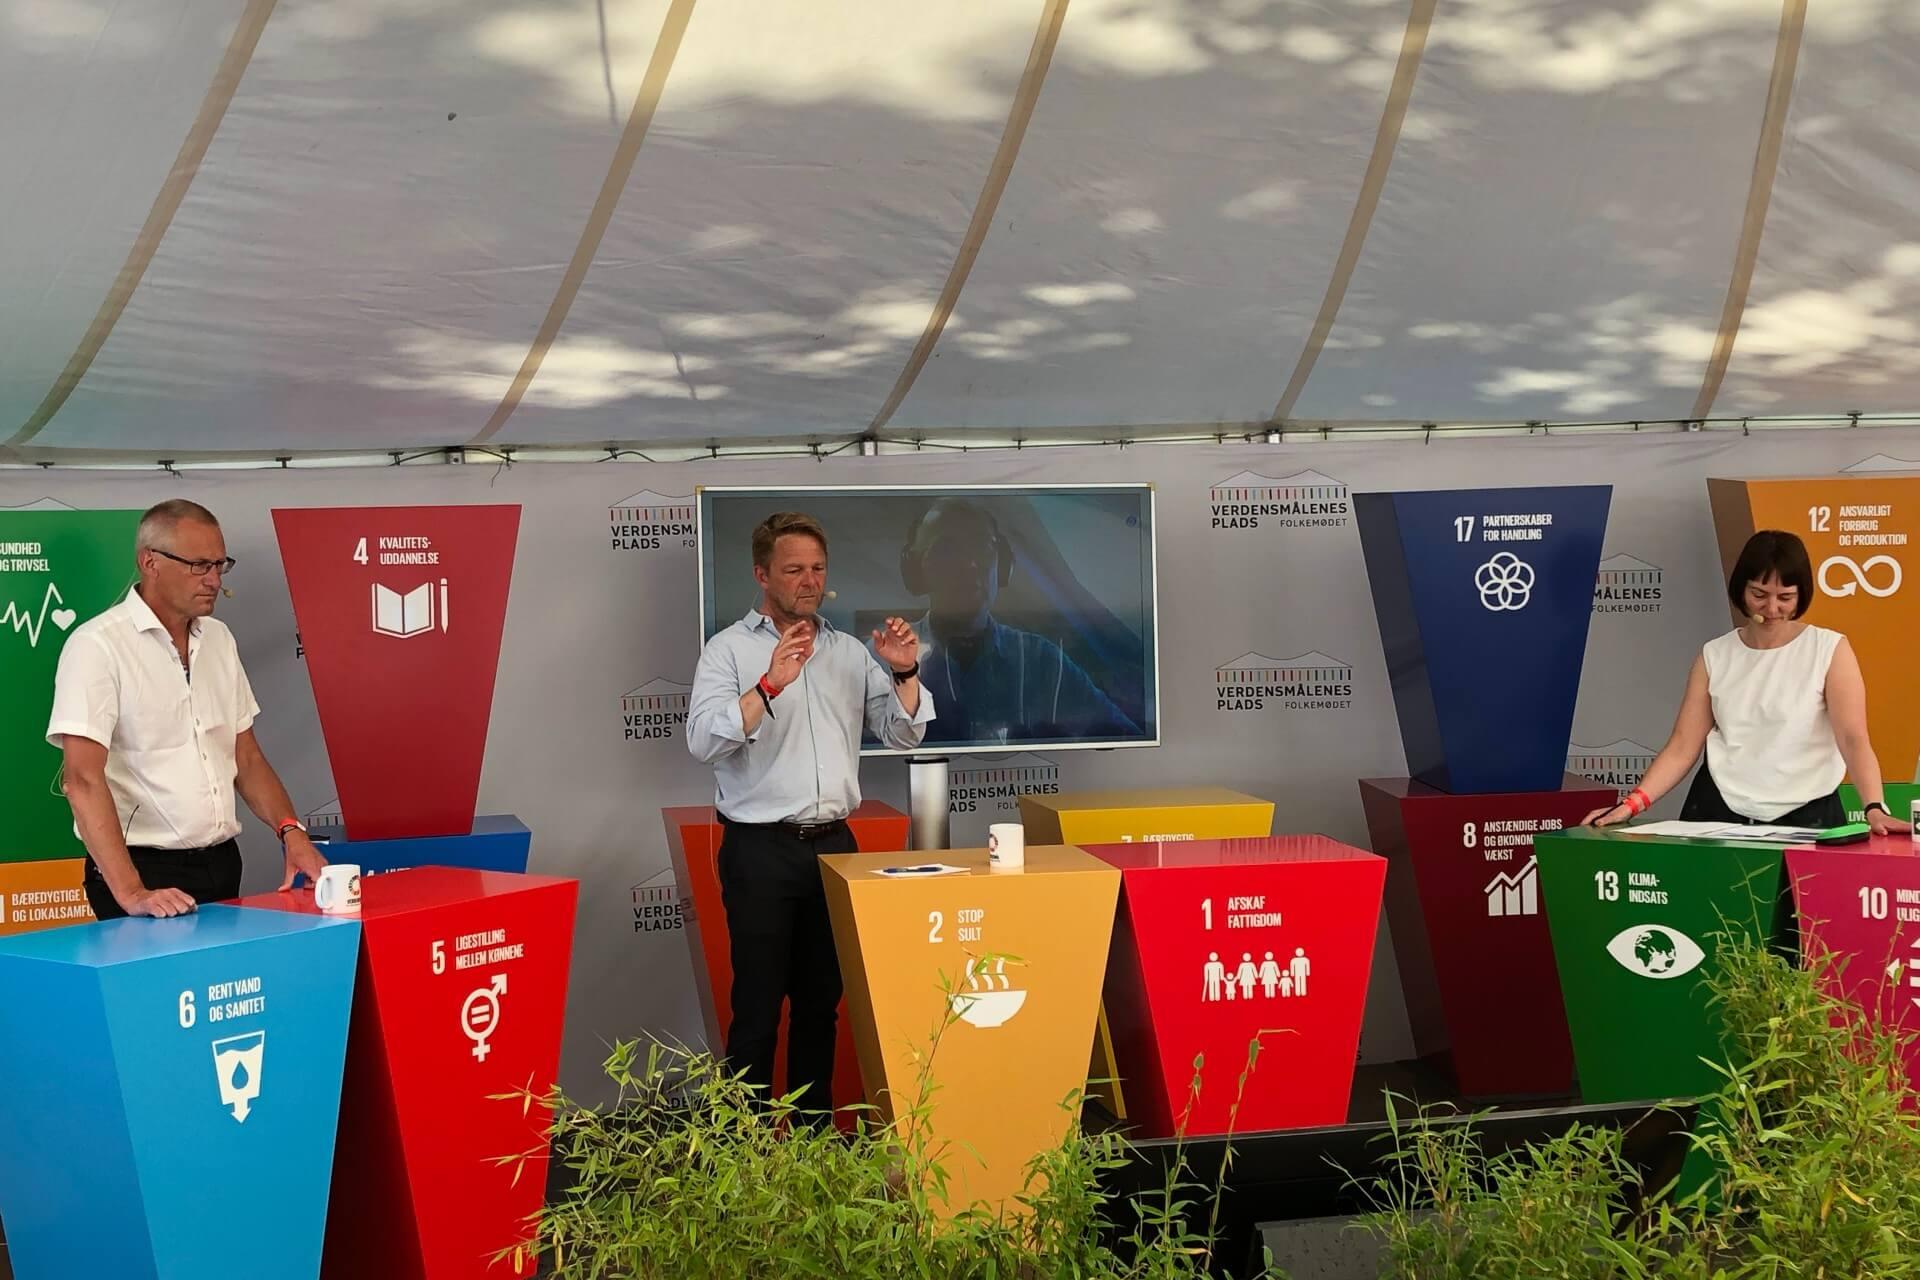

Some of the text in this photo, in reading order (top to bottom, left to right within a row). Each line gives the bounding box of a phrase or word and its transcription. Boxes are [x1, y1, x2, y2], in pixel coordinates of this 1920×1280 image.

[1211, 502, 1347, 516] VERDENSMÅLENES
[1840, 505, 1892, 517] ANSVARLIGT
[1212, 517, 1347, 529] PLADS FOLKEMØDET
[1483, 514, 1553, 527] PARTNERSKABER
[1808, 506, 1831, 532] 12
[1840, 520, 1878, 532] FORBRUG
[611, 524, 697, 537] VERDENSM
[1454, 516, 1475, 542] 17
[1483, 528, 1543, 541] FOR HANDLING
[379, 537, 432, 549] KVALITETS-
[612, 538, 660, 550] PLADS
[1839, 534, 1907, 546] OG PRODUKTION
[0, 542, 42, 555] UNDHED
[353, 537, 369, 565] 4
[10, 559, 50, 572] TRIVSEL
[380, 552, 440, 565] UDDANNELSE
[1217, 684, 1352, 698] VERDENSMÅLENES
[1217, 699, 1352, 711] PLADS FOLKEMØDET
[625, 727, 672, 740] PLADS
[1484, 819, 1563, 832] ANSTÆNDIGE JOBS
[1463, 823, 1476, 848] 8
[1484, 835, 1496, 847] OG
[1484, 849, 1514, 861] VÆKST
[1595, 870, 1620, 901] 13
[1628, 872, 1661, 887] KLIMA-
[12, 888, 80, 906] BÆREDYGTIGE
[1227, 896, 1266, 911] AFSKAF
[1628, 889, 1669, 905] INDSATS
[1858, 886, 1888, 920] 10
[12, 904, 95, 922] OG LOKALSAMFU
[957, 909, 984, 924] STOP
[1201, 898, 1213, 930] 1
[634, 918, 683, 932] PLADS
[928, 911, 944, 944] 2
[1227, 913, 1282, 929] FATTIGDOM
[455, 928, 506, 952] LIGESTILLING
[958, 927, 982, 942] SULT
[432, 940, 445, 975] 5
[455, 943, 524, 971] MELLEM KØNNENE
[208, 976, 261, 1002] RENT VAND
[179, 990, 196, 1028] 6
[209, 996, 265, 1023] OG SANITET
